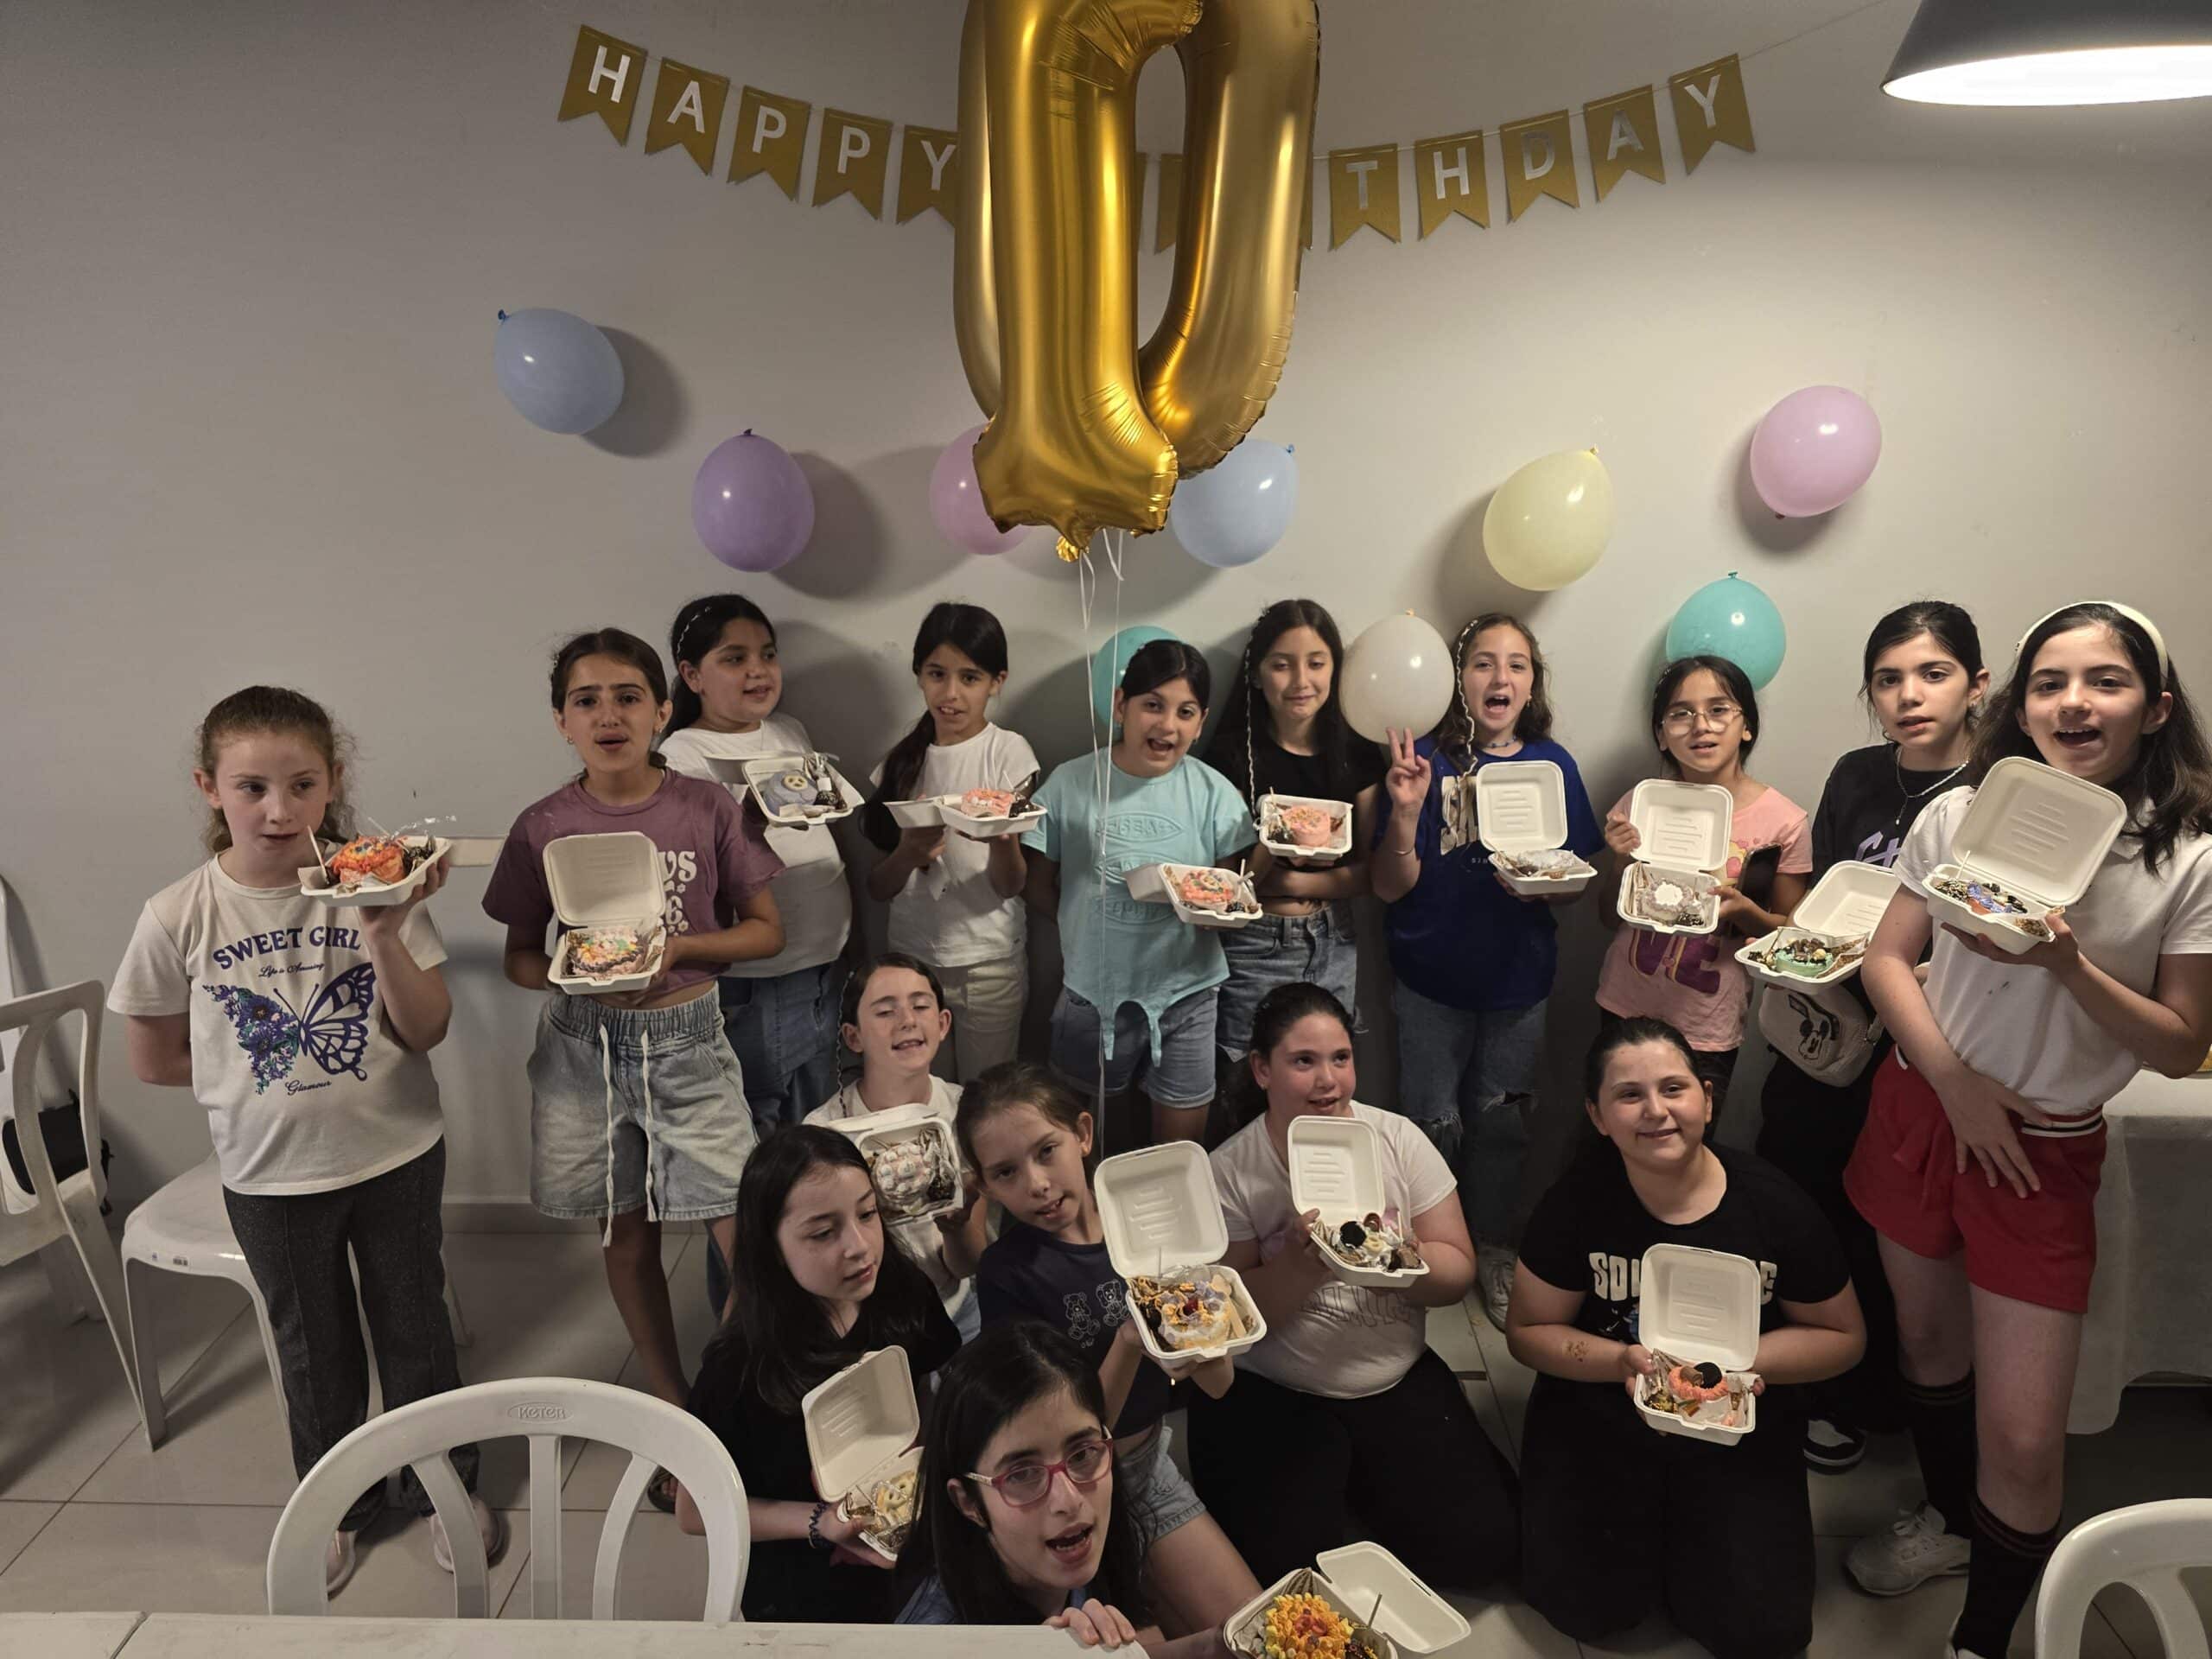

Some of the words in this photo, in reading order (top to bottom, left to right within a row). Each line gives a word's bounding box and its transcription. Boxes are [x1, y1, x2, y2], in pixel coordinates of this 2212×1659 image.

[588, 45, 957, 191] HAPPY
[1346, 74, 1722, 211] THDAY
[213, 927, 303, 969] SWEET
[309, 925, 361, 950] GIRL
[258, 964, 277, 978] Life
[284, 1080, 332, 1096] Glamour
